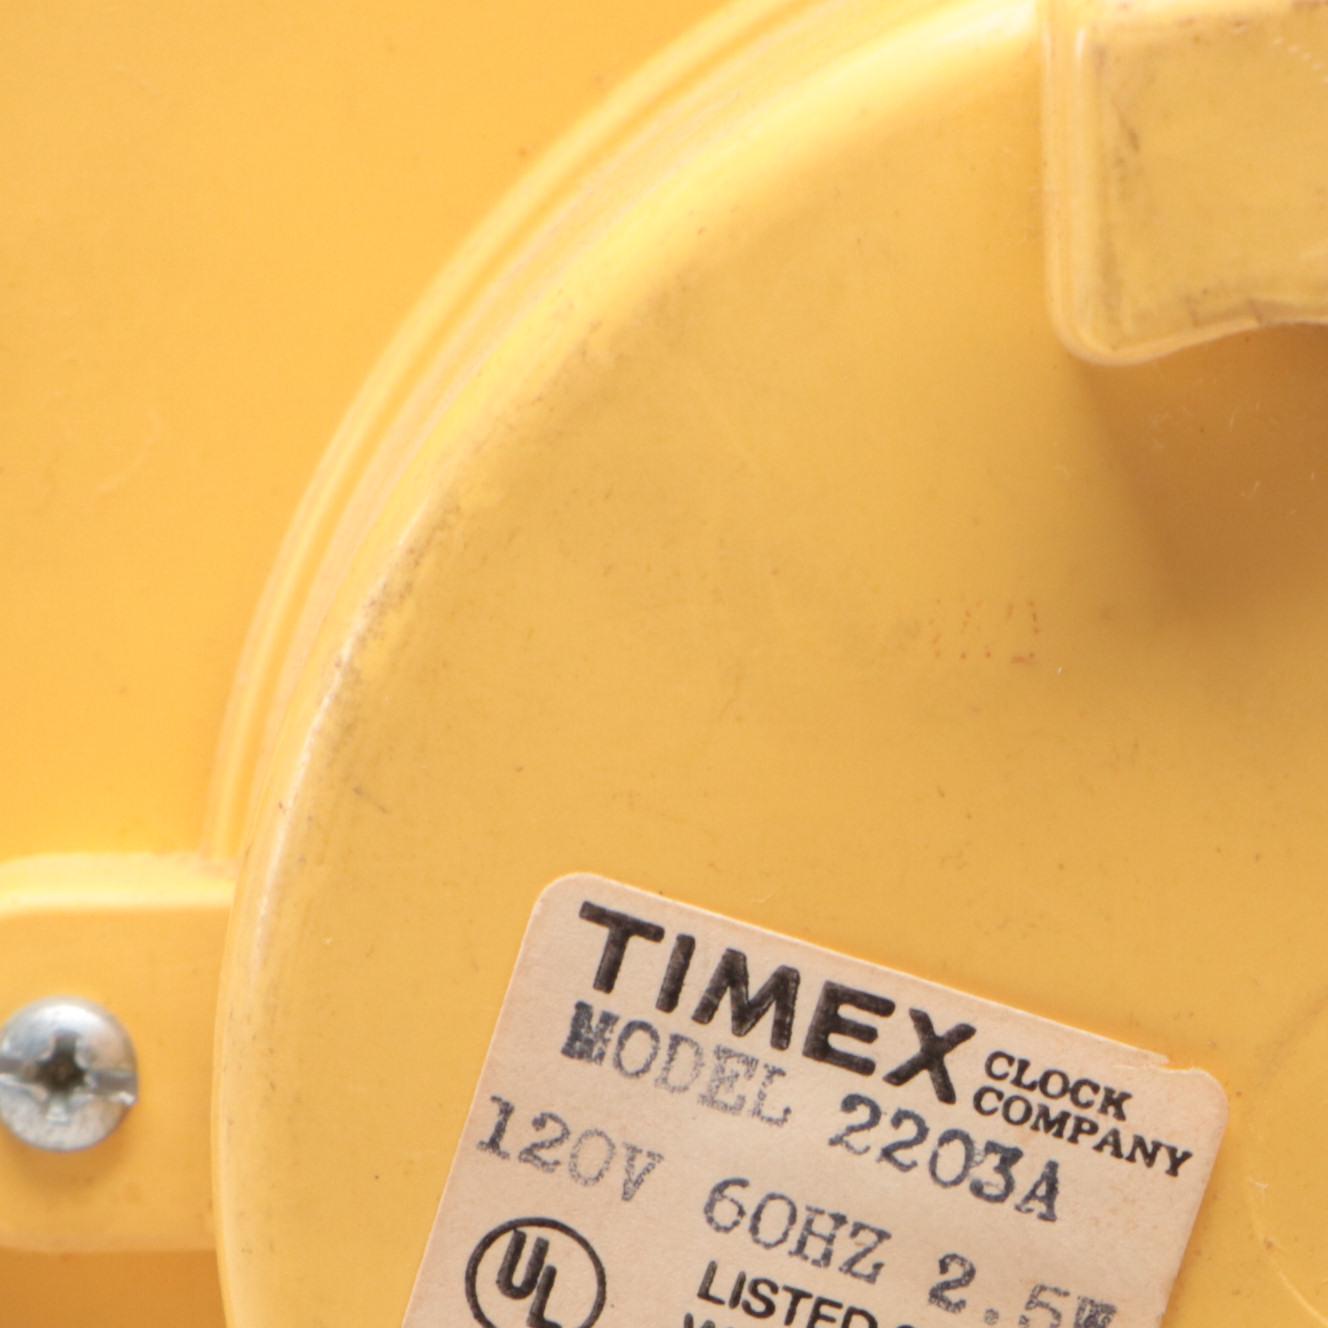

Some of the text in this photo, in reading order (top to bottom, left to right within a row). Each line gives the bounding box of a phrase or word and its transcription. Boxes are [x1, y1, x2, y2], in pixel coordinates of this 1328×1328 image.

[578, 900, 977, 1105] TIMEX
[984, 1051, 1133, 1122] CLOCK
[476, 1095, 665, 1203] 120V
[703, 1177, 893, 1285] 60HZ
[561, 1000, 1060, 1222] MODEL 2203A
[972, 1085, 1193, 1178] COMPANY
